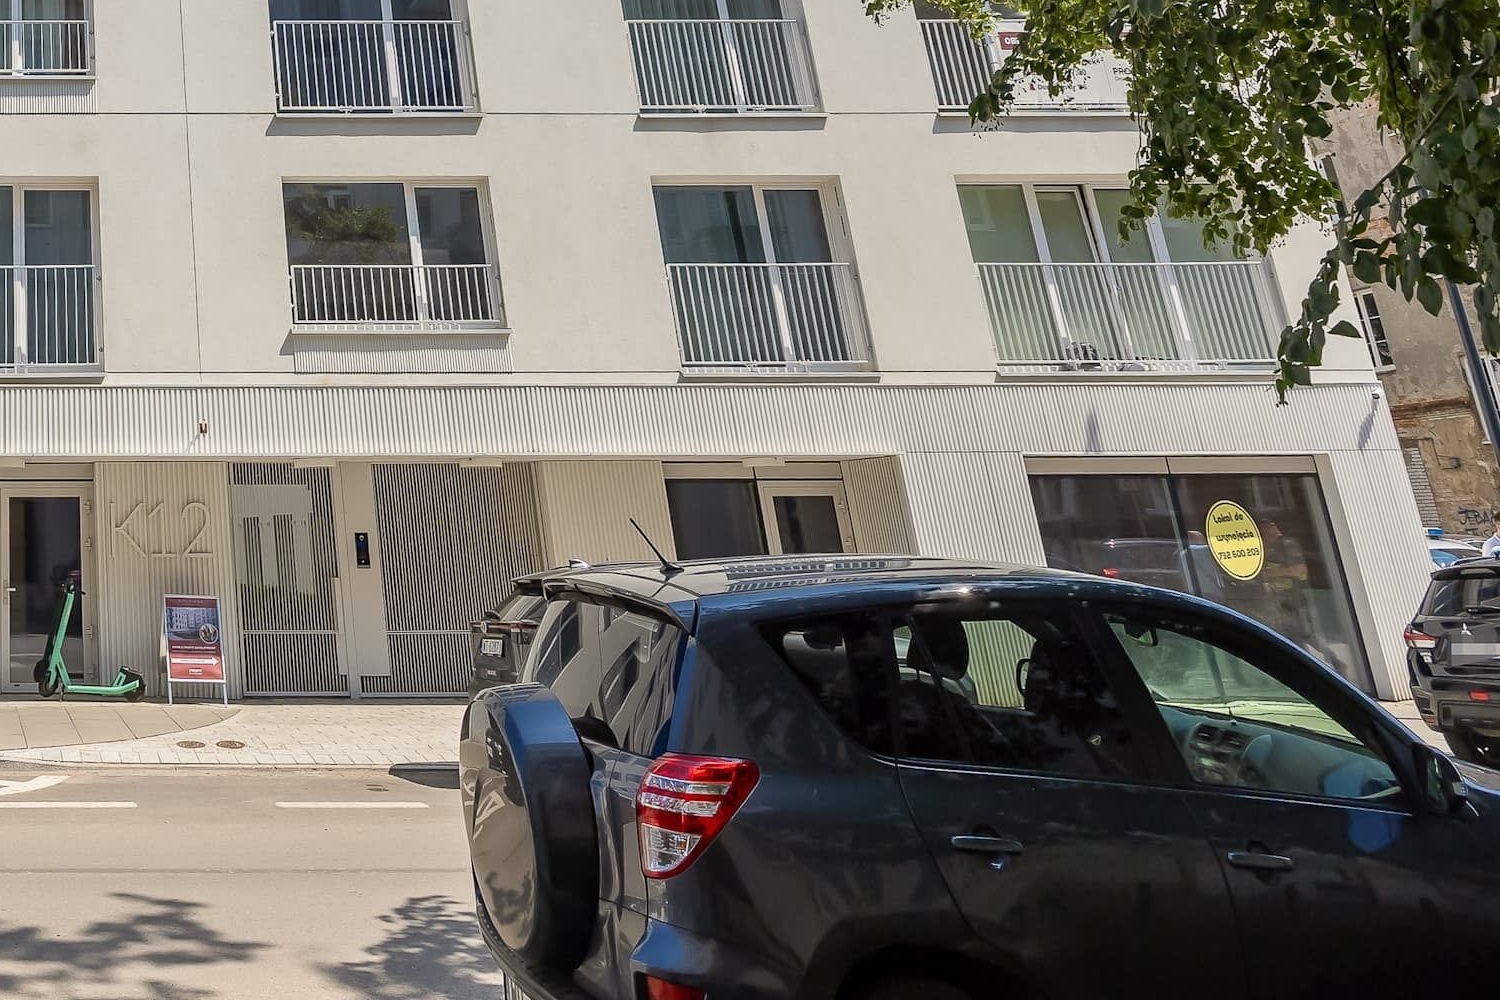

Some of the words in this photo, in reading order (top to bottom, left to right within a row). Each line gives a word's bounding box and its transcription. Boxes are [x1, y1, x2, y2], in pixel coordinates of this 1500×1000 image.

[108, 500, 214, 559] K12
[1212, 511, 1234, 524] Lokal
[1234, 511, 1244, 521] do
